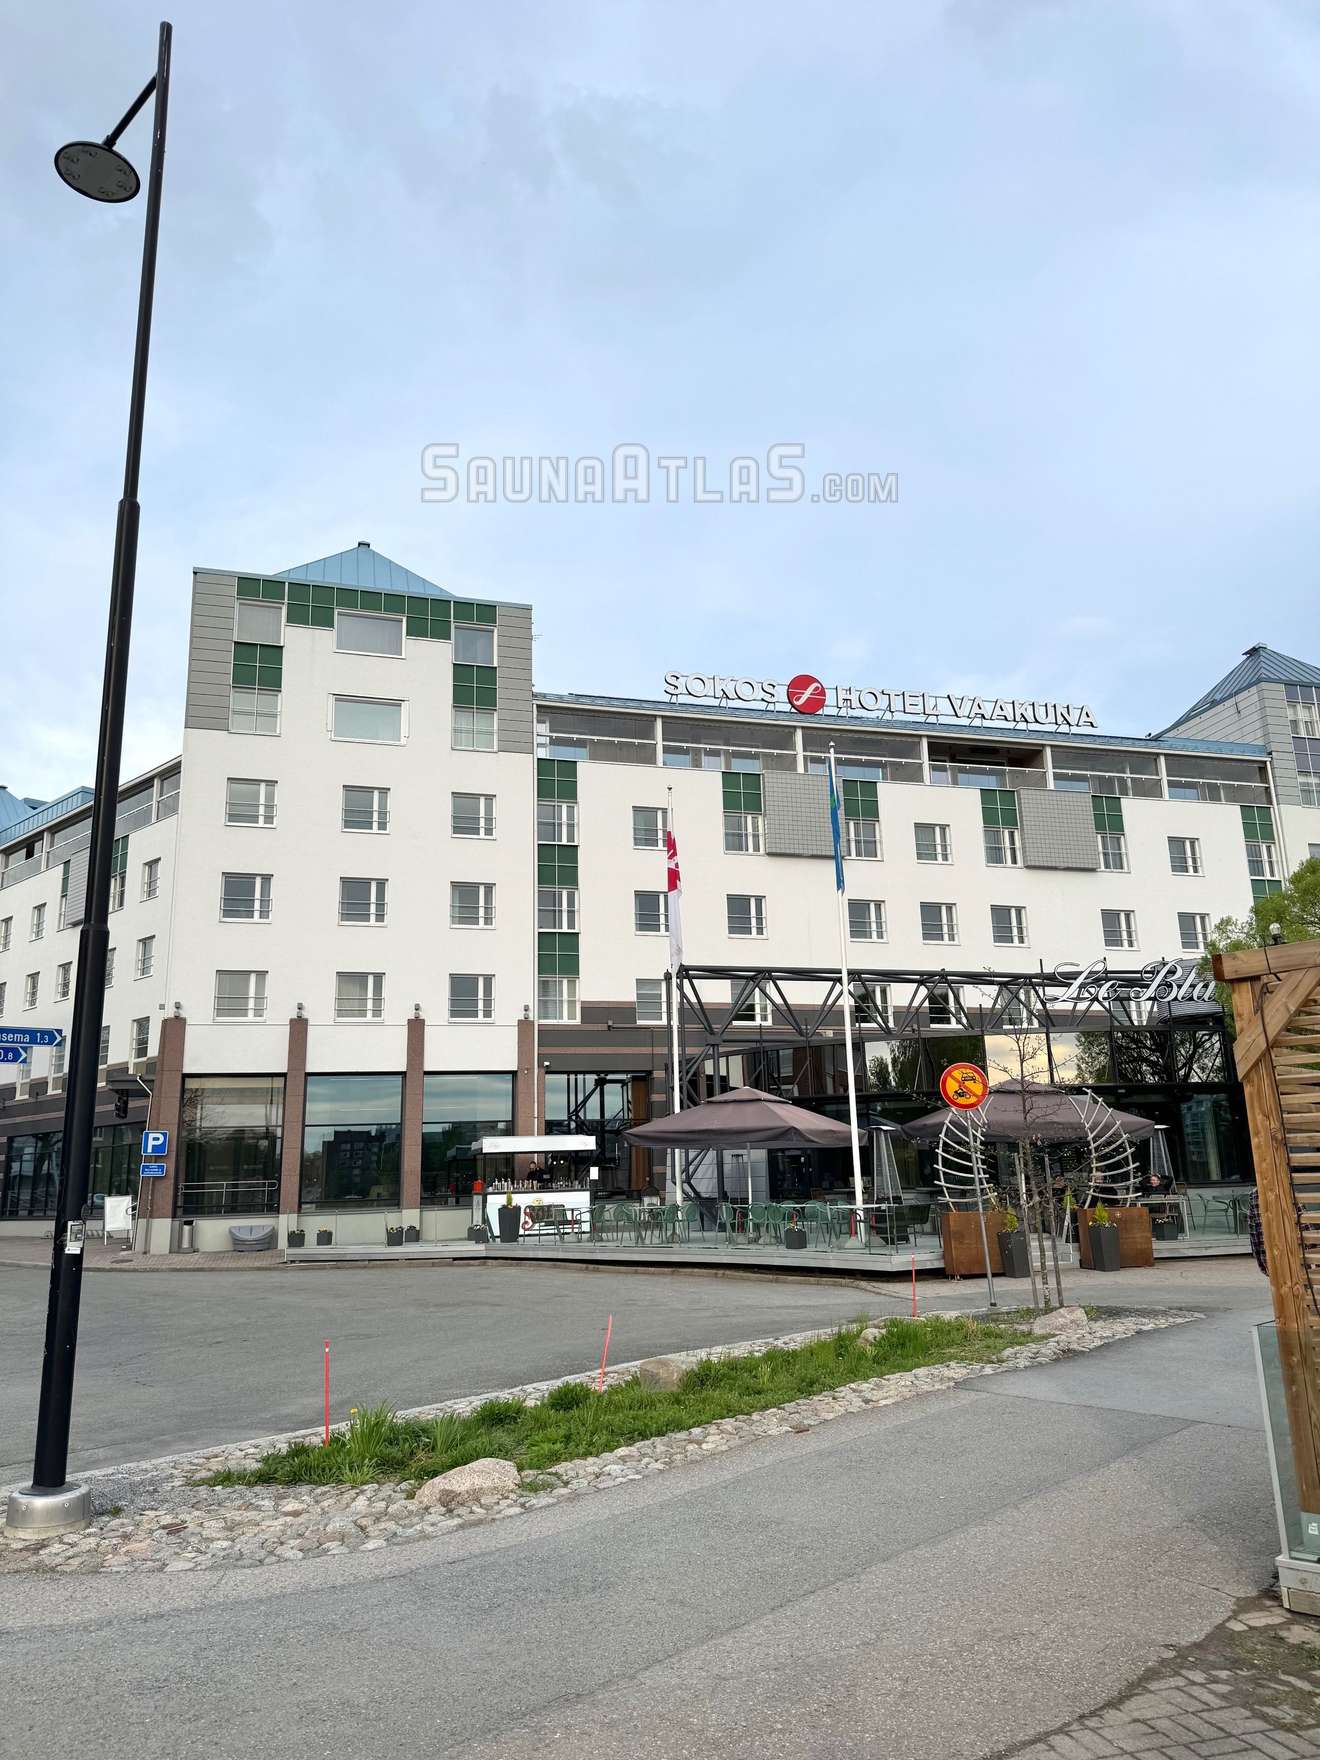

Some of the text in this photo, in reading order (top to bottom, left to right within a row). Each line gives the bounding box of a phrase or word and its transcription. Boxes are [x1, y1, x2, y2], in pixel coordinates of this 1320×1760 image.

[664, 671, 1098, 728] SOKOS HOTEL VAAKUNA
[1043, 960, 1121, 1002] Le
[0, 1032, 49, 1043] sema 1.3
[147, 1133, 164, 1153] P
